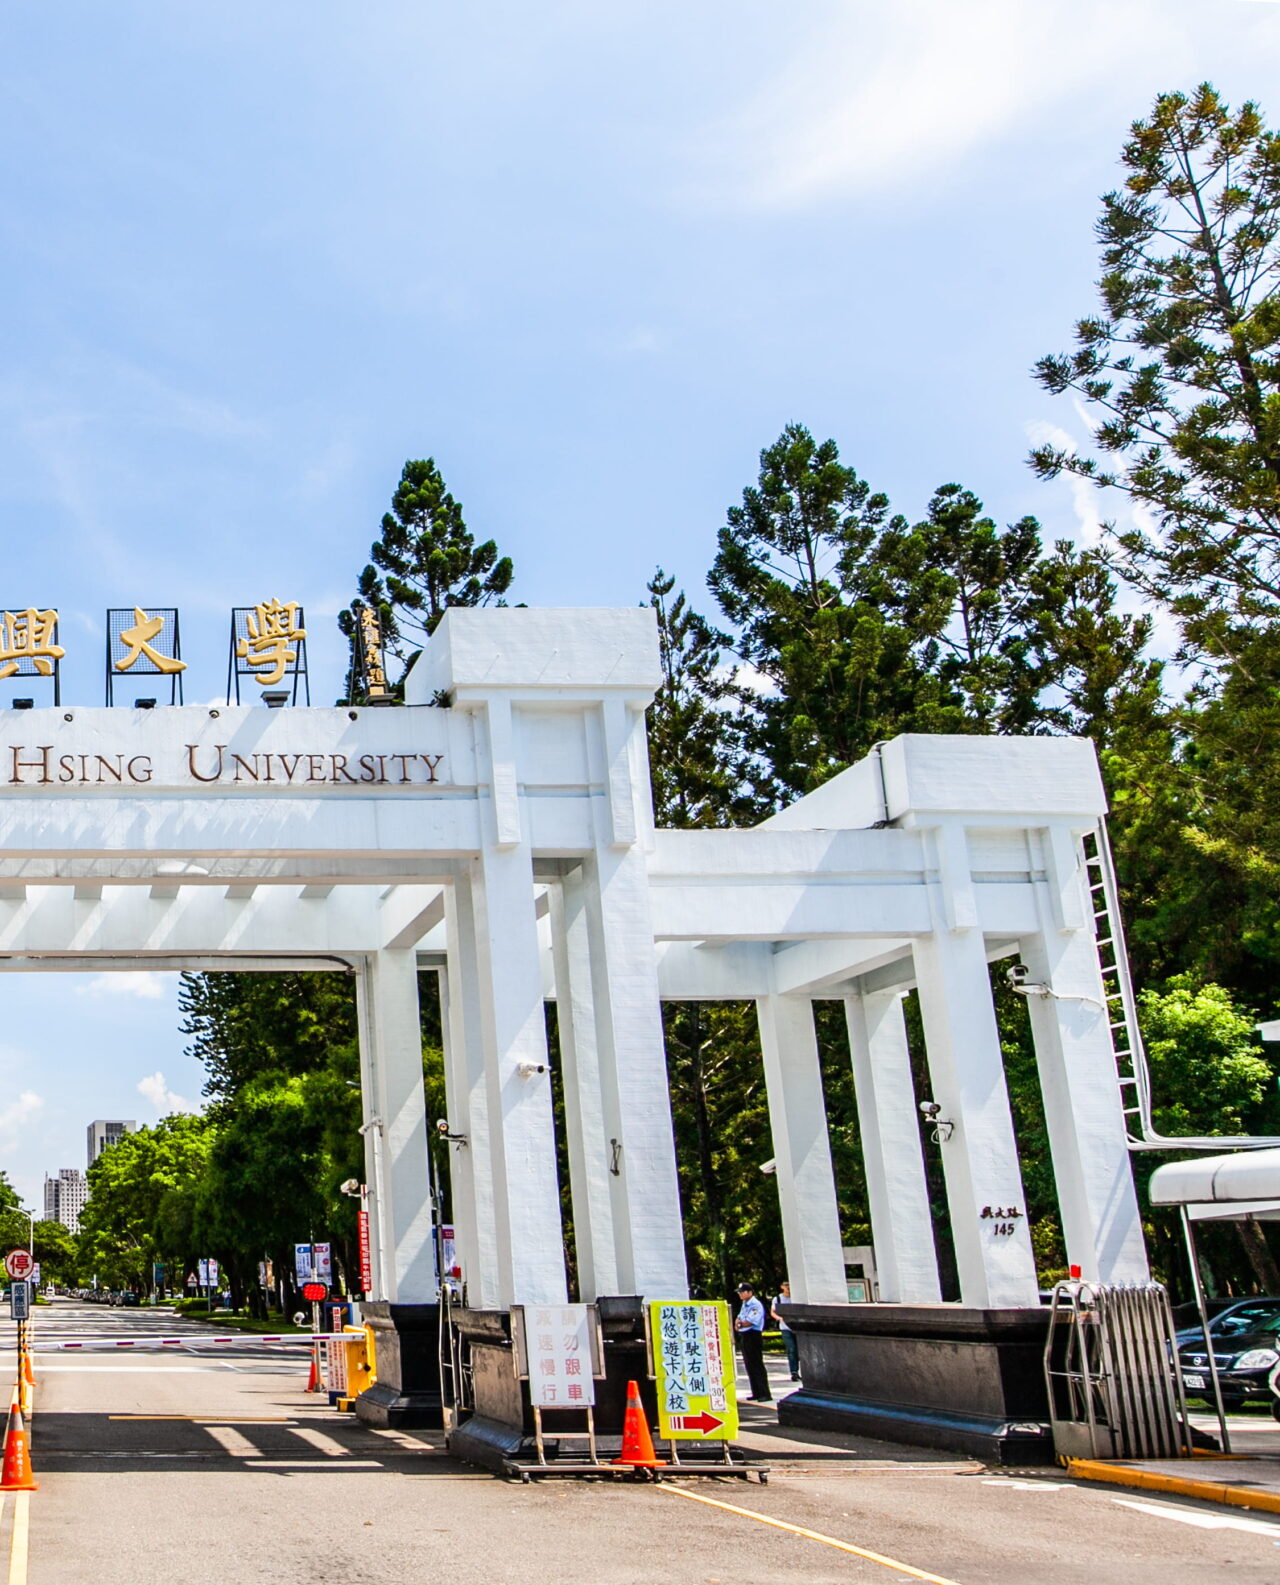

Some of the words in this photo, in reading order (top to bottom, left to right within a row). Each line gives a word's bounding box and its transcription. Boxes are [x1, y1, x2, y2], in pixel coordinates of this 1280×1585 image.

[8, 745, 154, 784] HSING
[185, 744, 445, 784] UNIVERSITY
[994, 1223, 1015, 1236] 145
[10, 1254, 29, 1274] 停
[561, 1309, 583, 1400] 請勿跟車
[662, 1306, 686, 1410] 以悠遊卡入校
[681, 1306, 705, 1393] 請行駛右側
